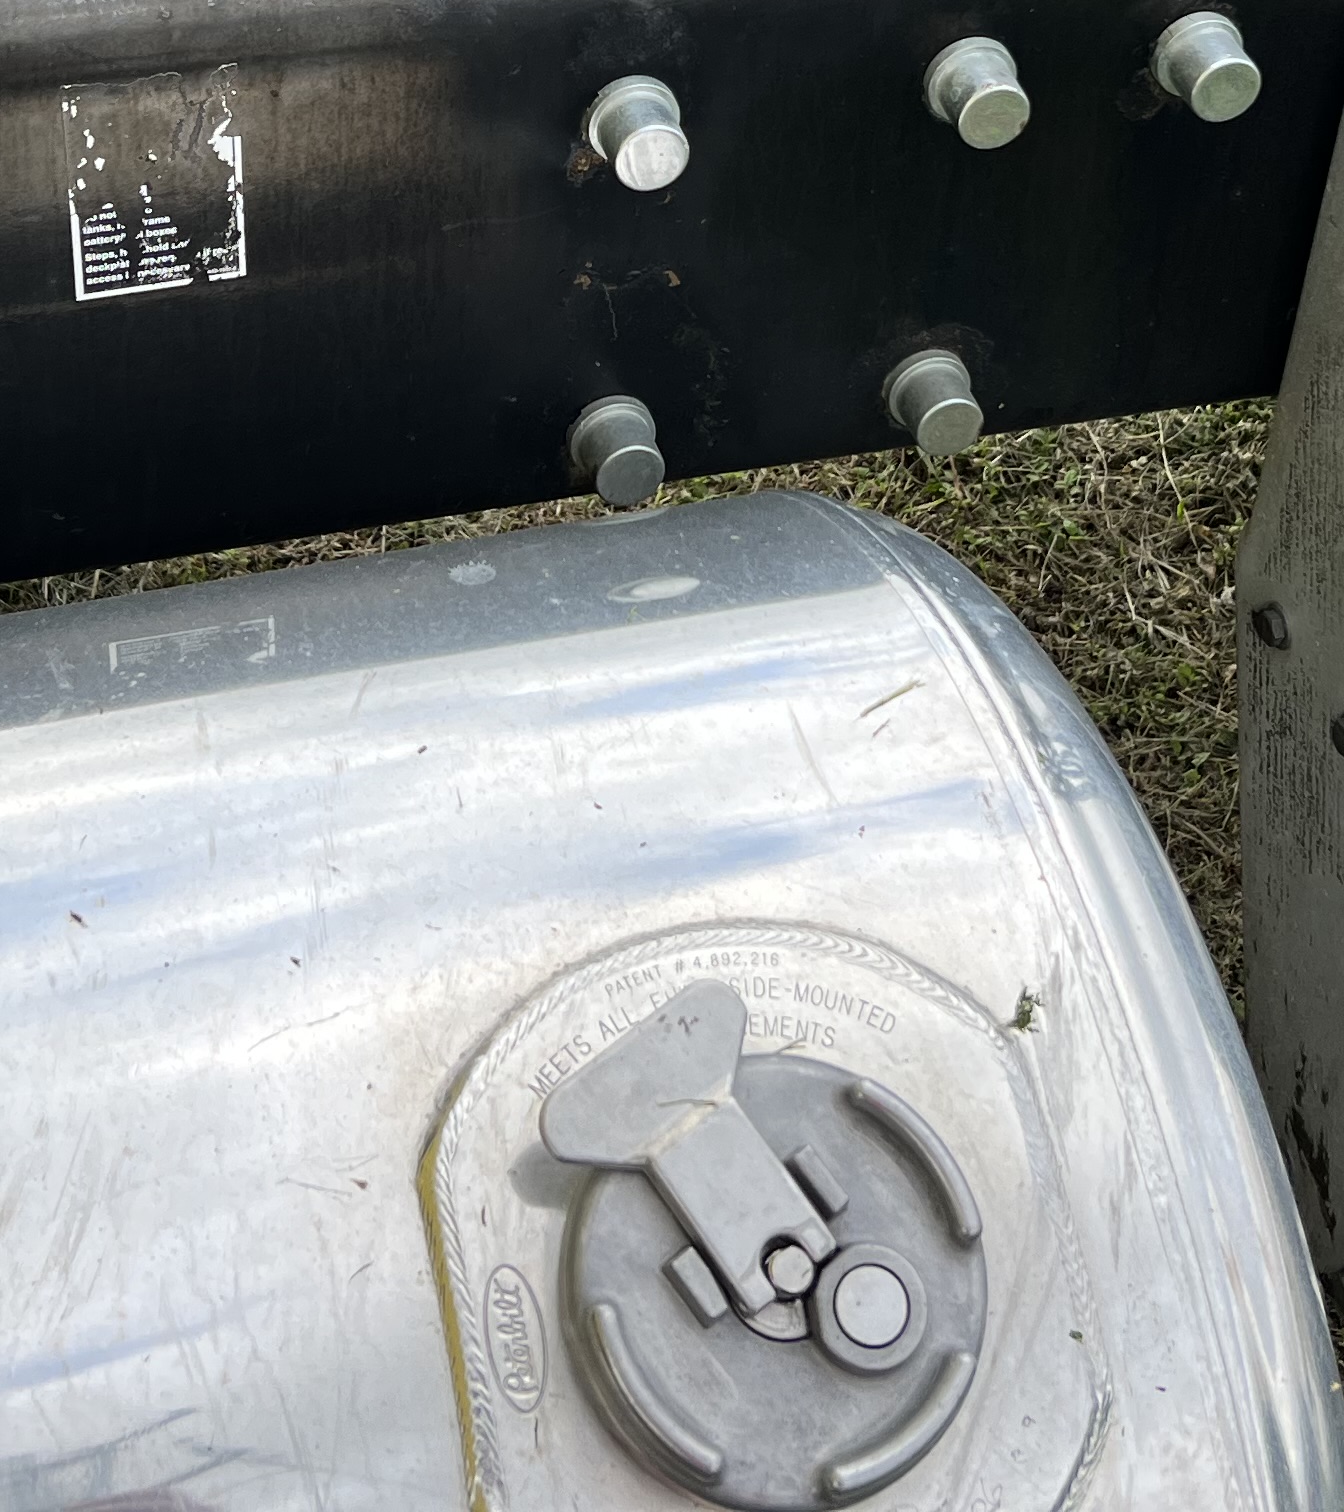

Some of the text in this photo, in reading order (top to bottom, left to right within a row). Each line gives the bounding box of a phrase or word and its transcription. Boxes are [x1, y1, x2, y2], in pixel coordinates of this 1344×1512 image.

[604, 964, 662, 998] PATENT
[527, 1034, 592, 1101] MEETS
[598, 1006, 642, 1042] ALL
[728, 976, 896, 1035] SIDE-MOUNTED
[745, 1013, 836, 1048] EMENTS
[493, 1276, 539, 1392] Peterbilt
